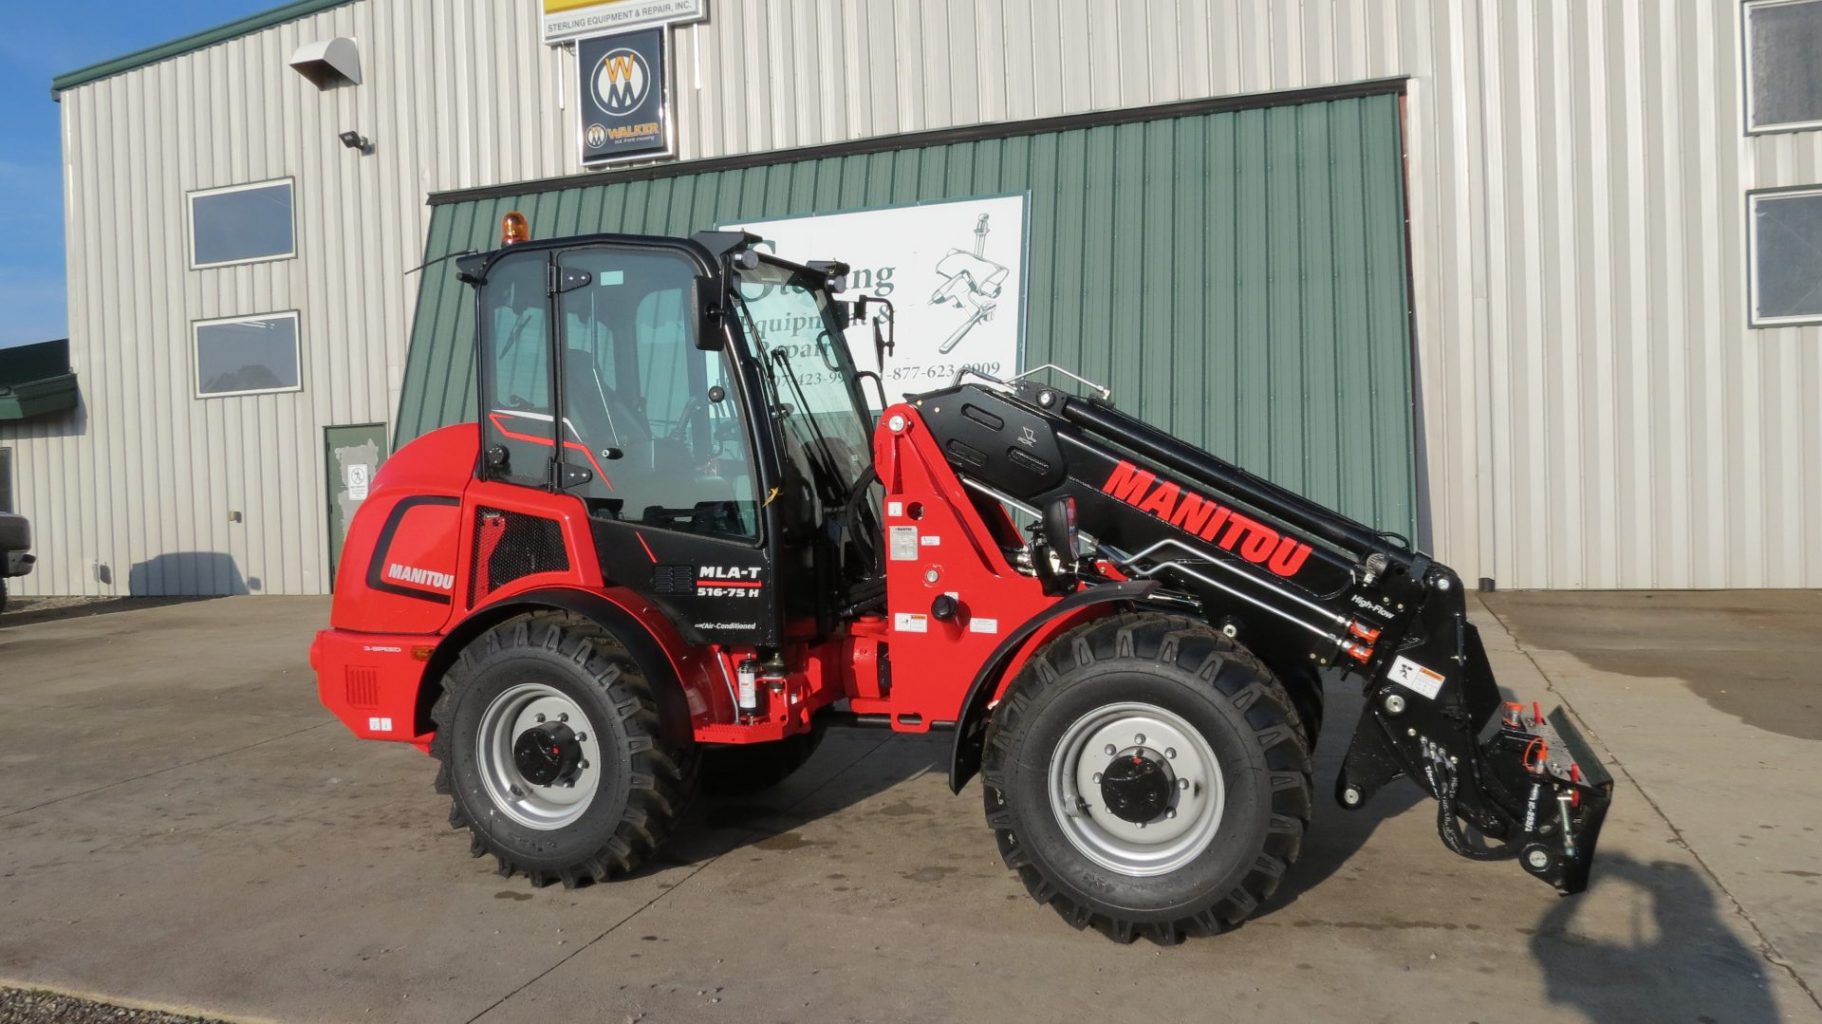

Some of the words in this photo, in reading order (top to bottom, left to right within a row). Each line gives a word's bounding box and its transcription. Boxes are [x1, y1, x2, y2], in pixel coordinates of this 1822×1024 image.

[547, 18, 586, 33] STERLING
[587, 9, 633, 26] EQUIPMENT
[634, 9, 640, 18] &
[641, 4, 673, 17] REPAIR,
[674, 0, 692, 11] INC.
[607, 122, 659, 140] WALKER
[1102, 459, 1313, 577] MANITOU
[388, 563, 455, 590] MANITOU
[699, 566, 762, 579] MLA-T
[697, 587, 746, 597] 516-75
[748, 588, 760, 598] H
[1351, 594, 1395, 619] High-Flow
[704, 622, 757, 630] Air-Conditioned
